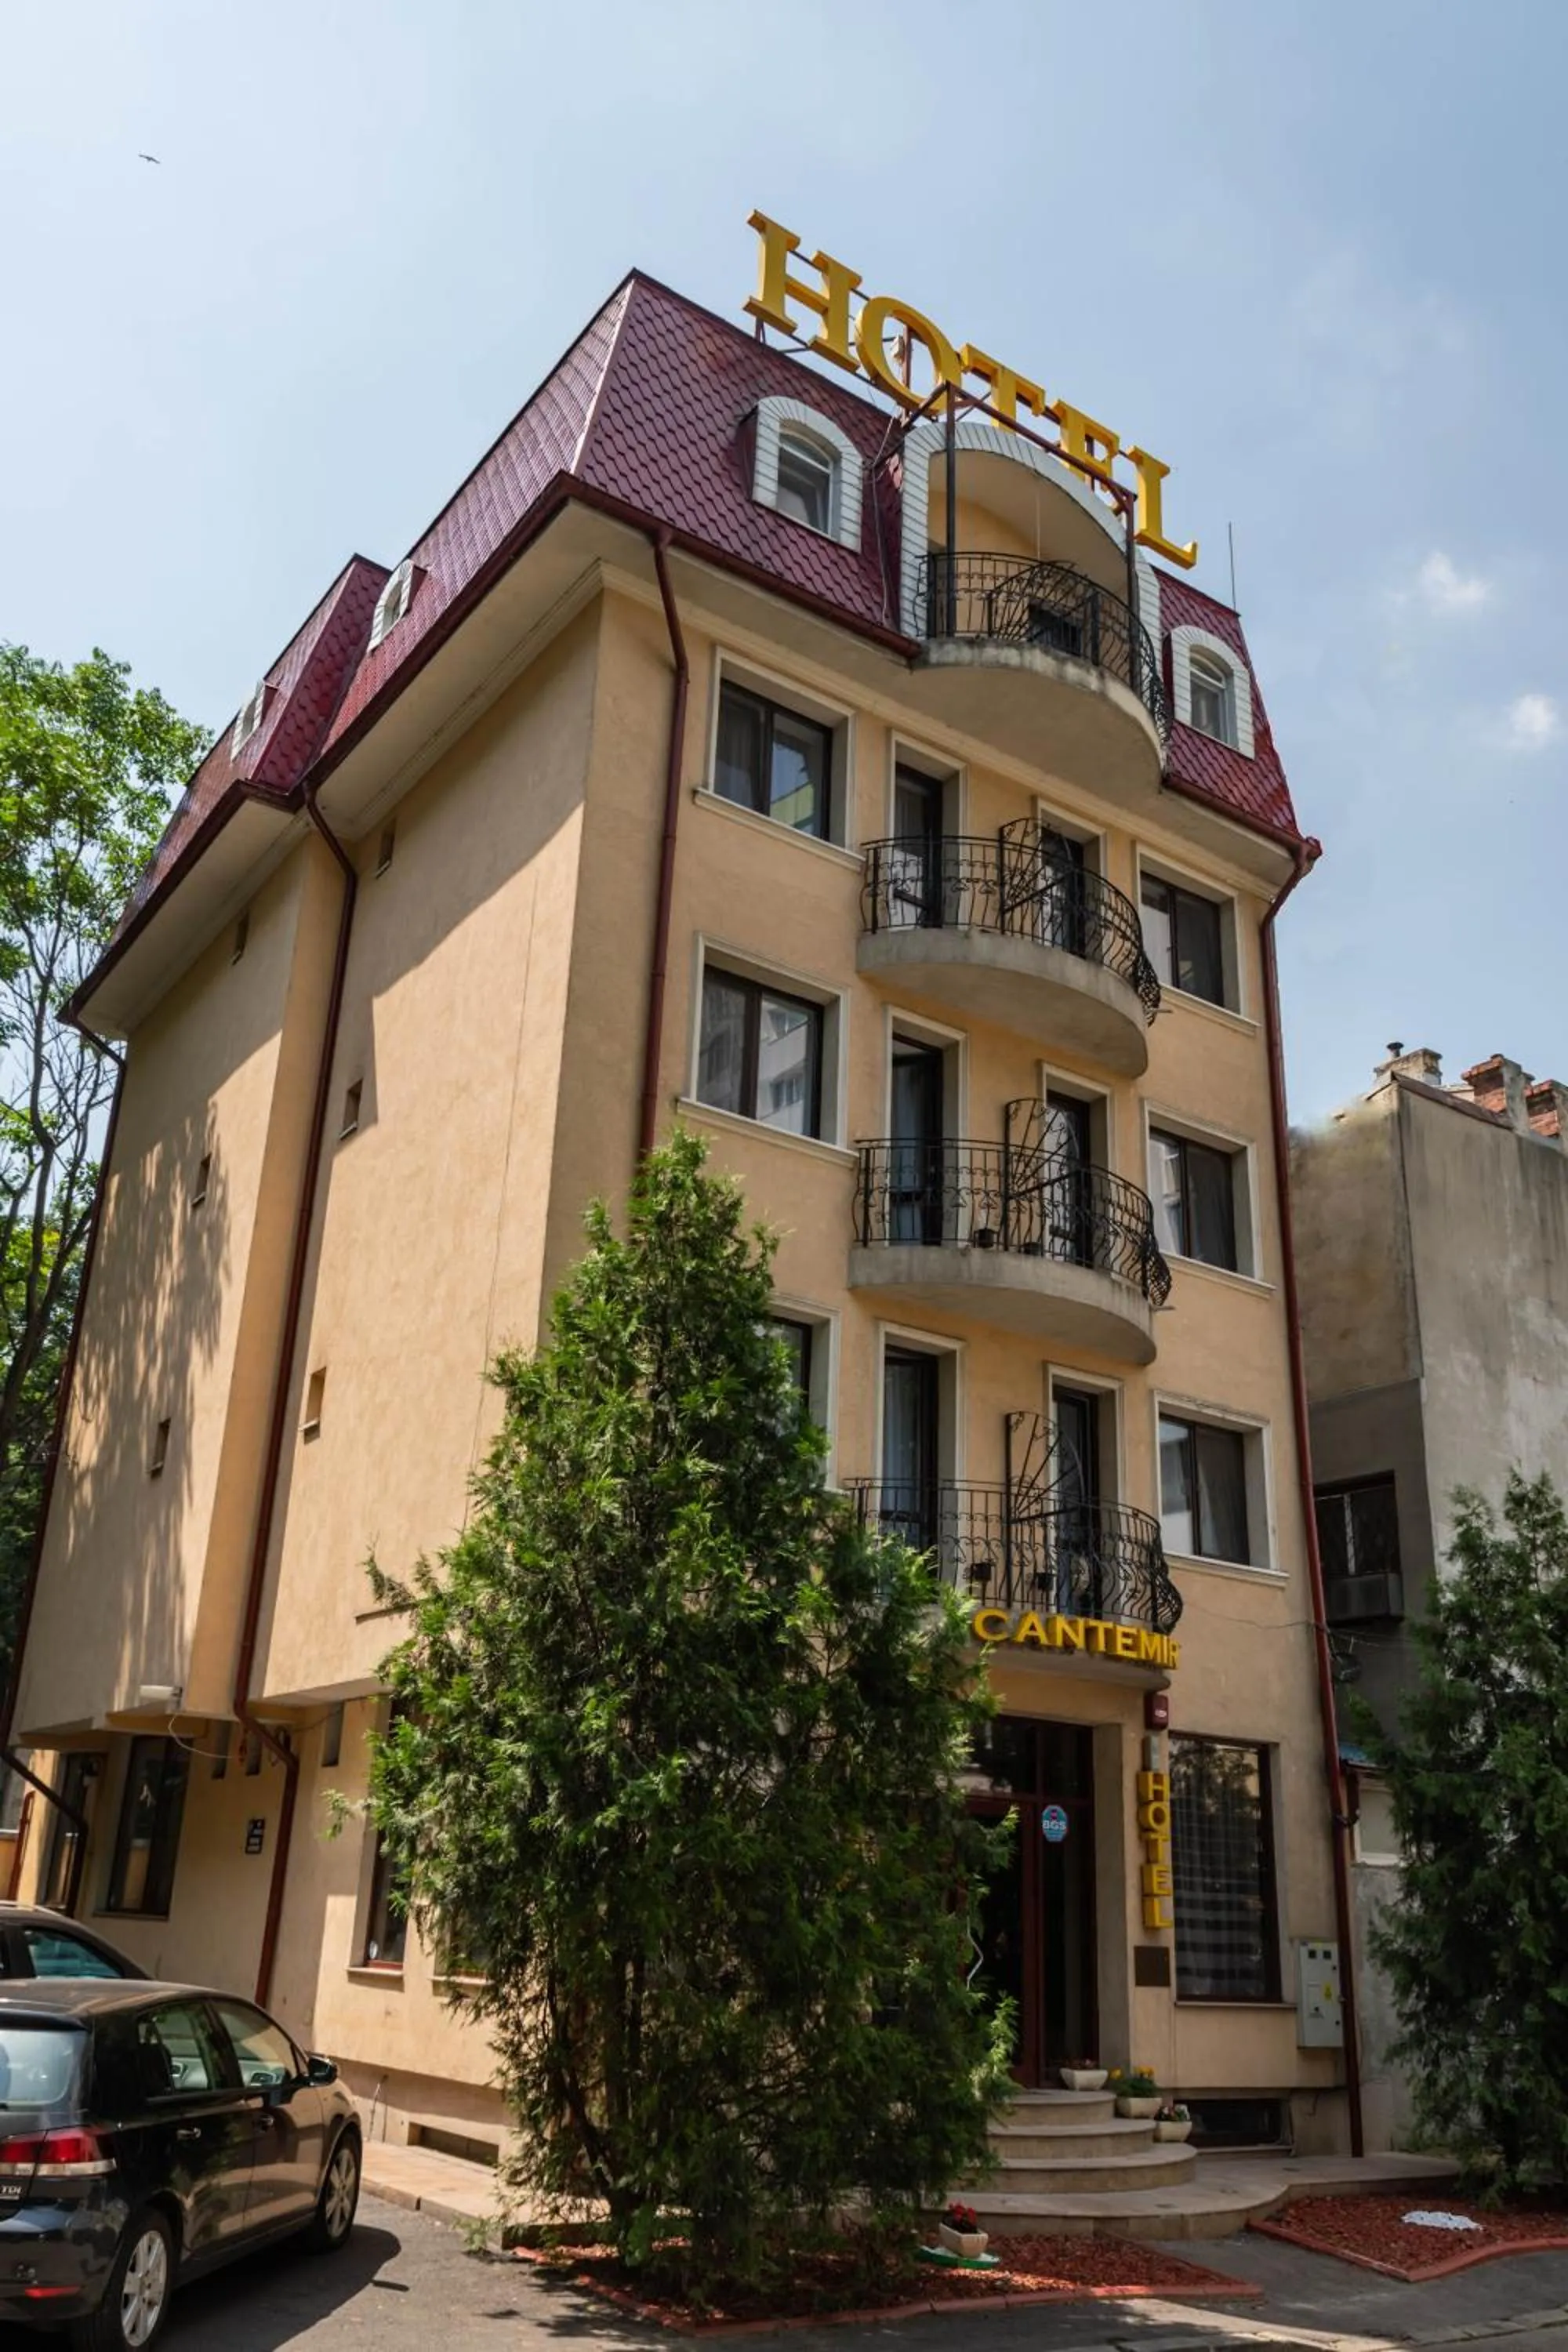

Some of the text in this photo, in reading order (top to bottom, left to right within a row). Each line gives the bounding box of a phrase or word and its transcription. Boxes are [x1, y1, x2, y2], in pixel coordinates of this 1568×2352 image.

[742, 209, 1197, 569] HOTEL
[972, 1607, 1181, 1670] CANTEMIR
[1138, 1771, 1173, 1929] HOTEL
